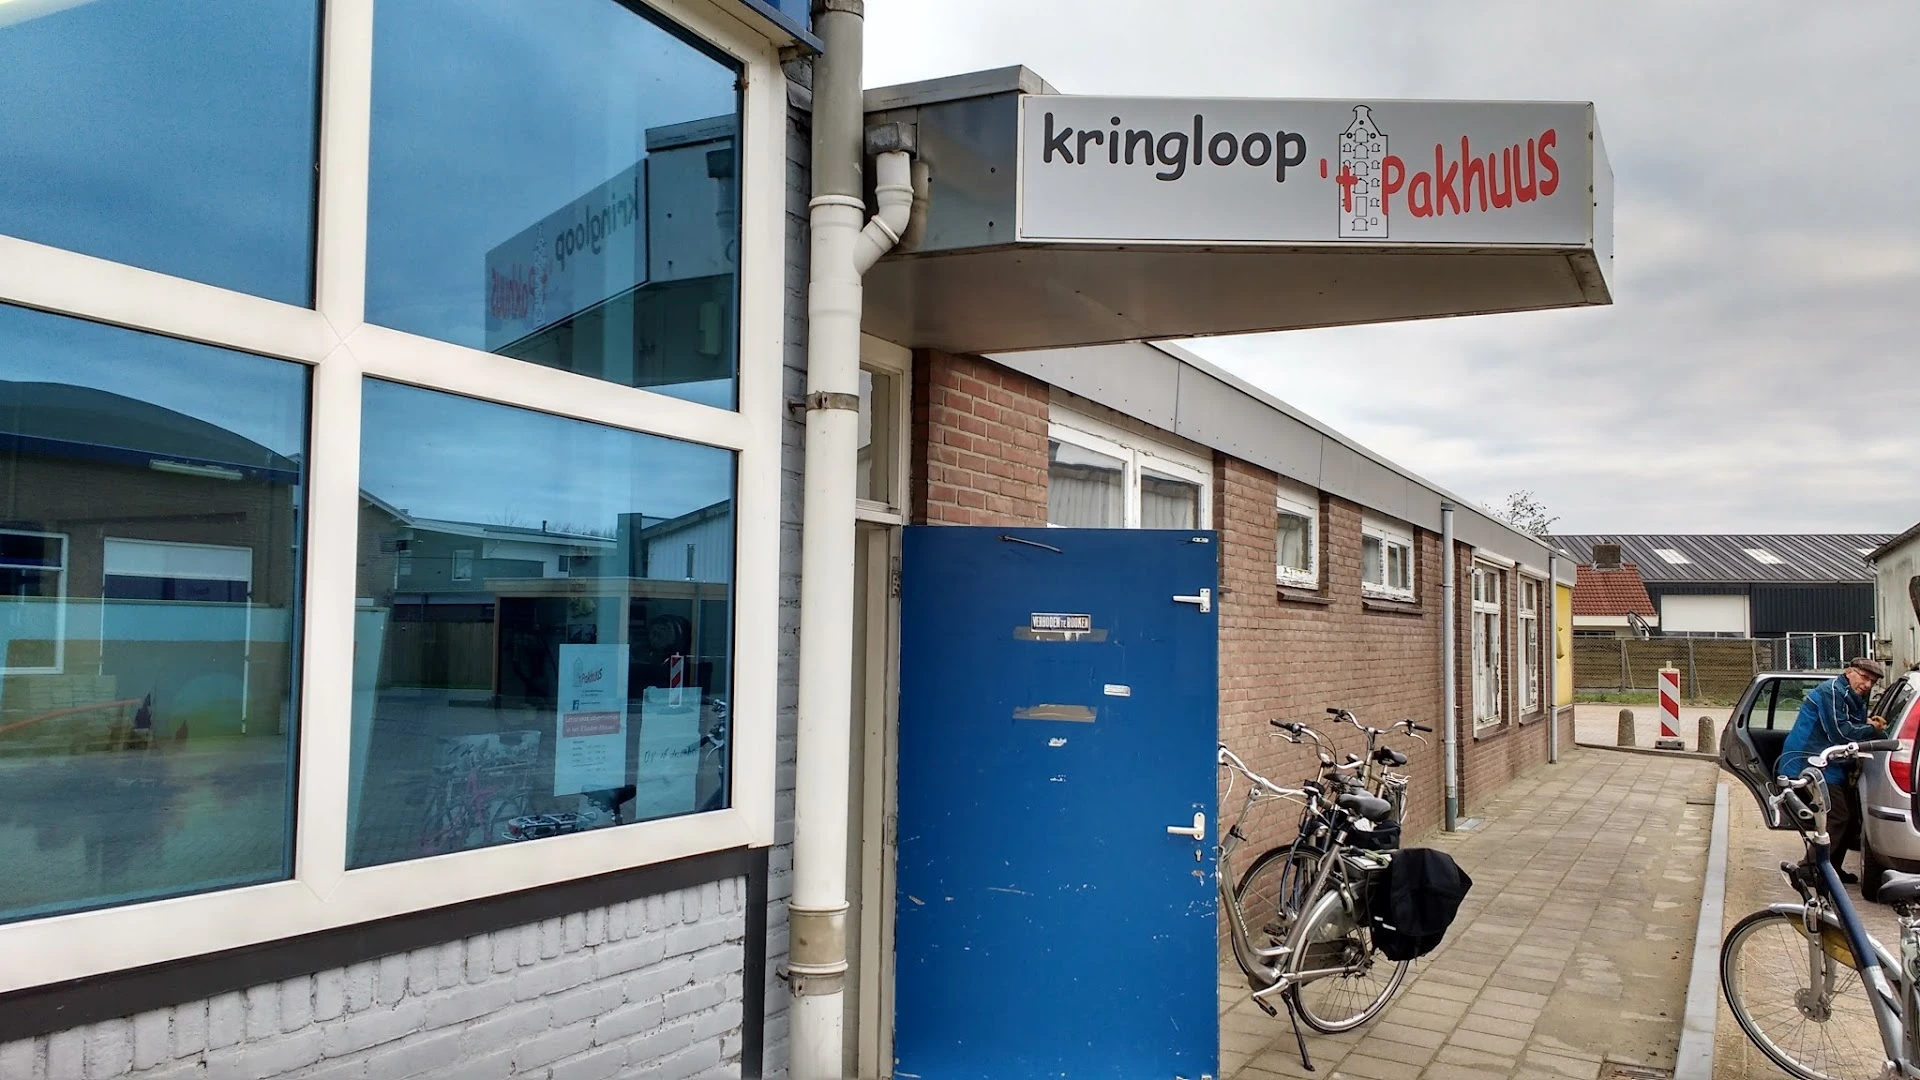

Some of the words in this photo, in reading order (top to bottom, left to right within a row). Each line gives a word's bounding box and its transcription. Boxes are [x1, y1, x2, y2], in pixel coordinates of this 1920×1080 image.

[1043, 111, 1307, 183] kringloop
[1320, 158, 1358, 213] 't
[1381, 128, 1559, 218] Pakhuus
[1032, 615, 1060, 628] VERBODEN
